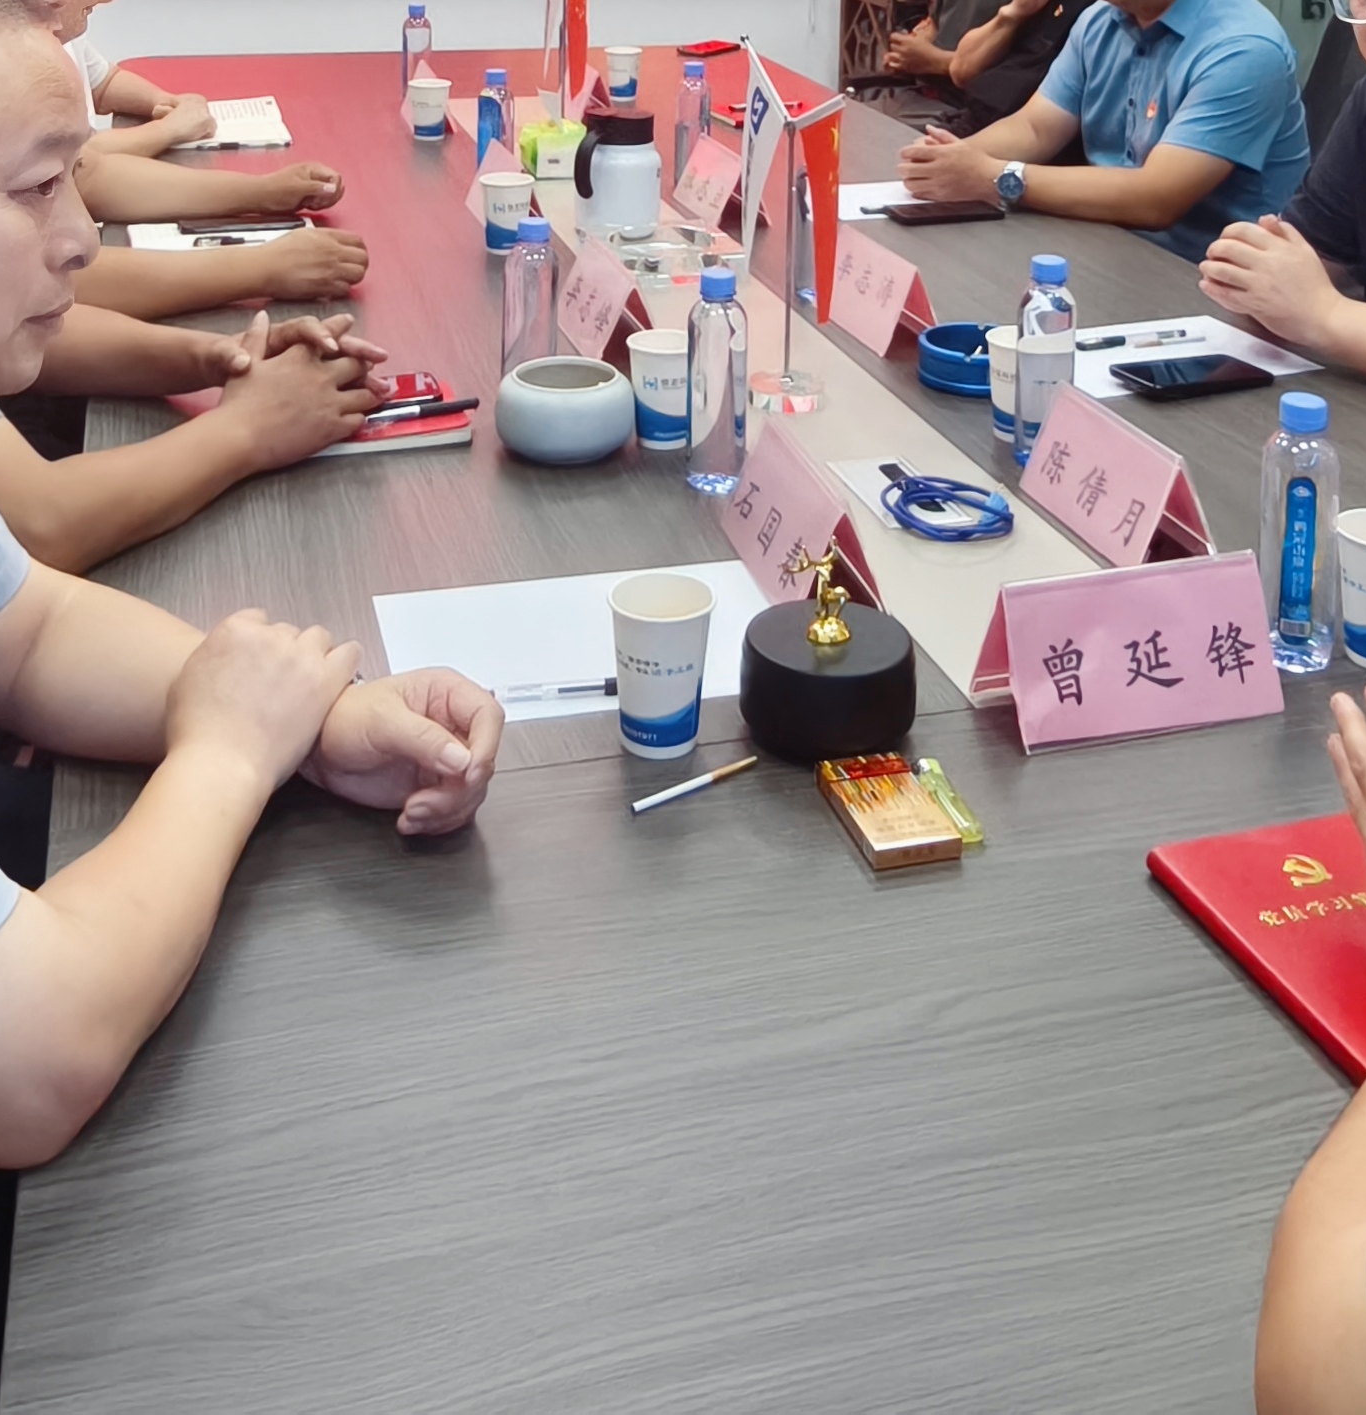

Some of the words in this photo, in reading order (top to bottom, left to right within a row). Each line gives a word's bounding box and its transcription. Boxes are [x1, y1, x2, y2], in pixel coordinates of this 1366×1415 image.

[1040, 440, 1146, 547] 陈倩月
[1042, 621, 1256, 706] 曾延锋
